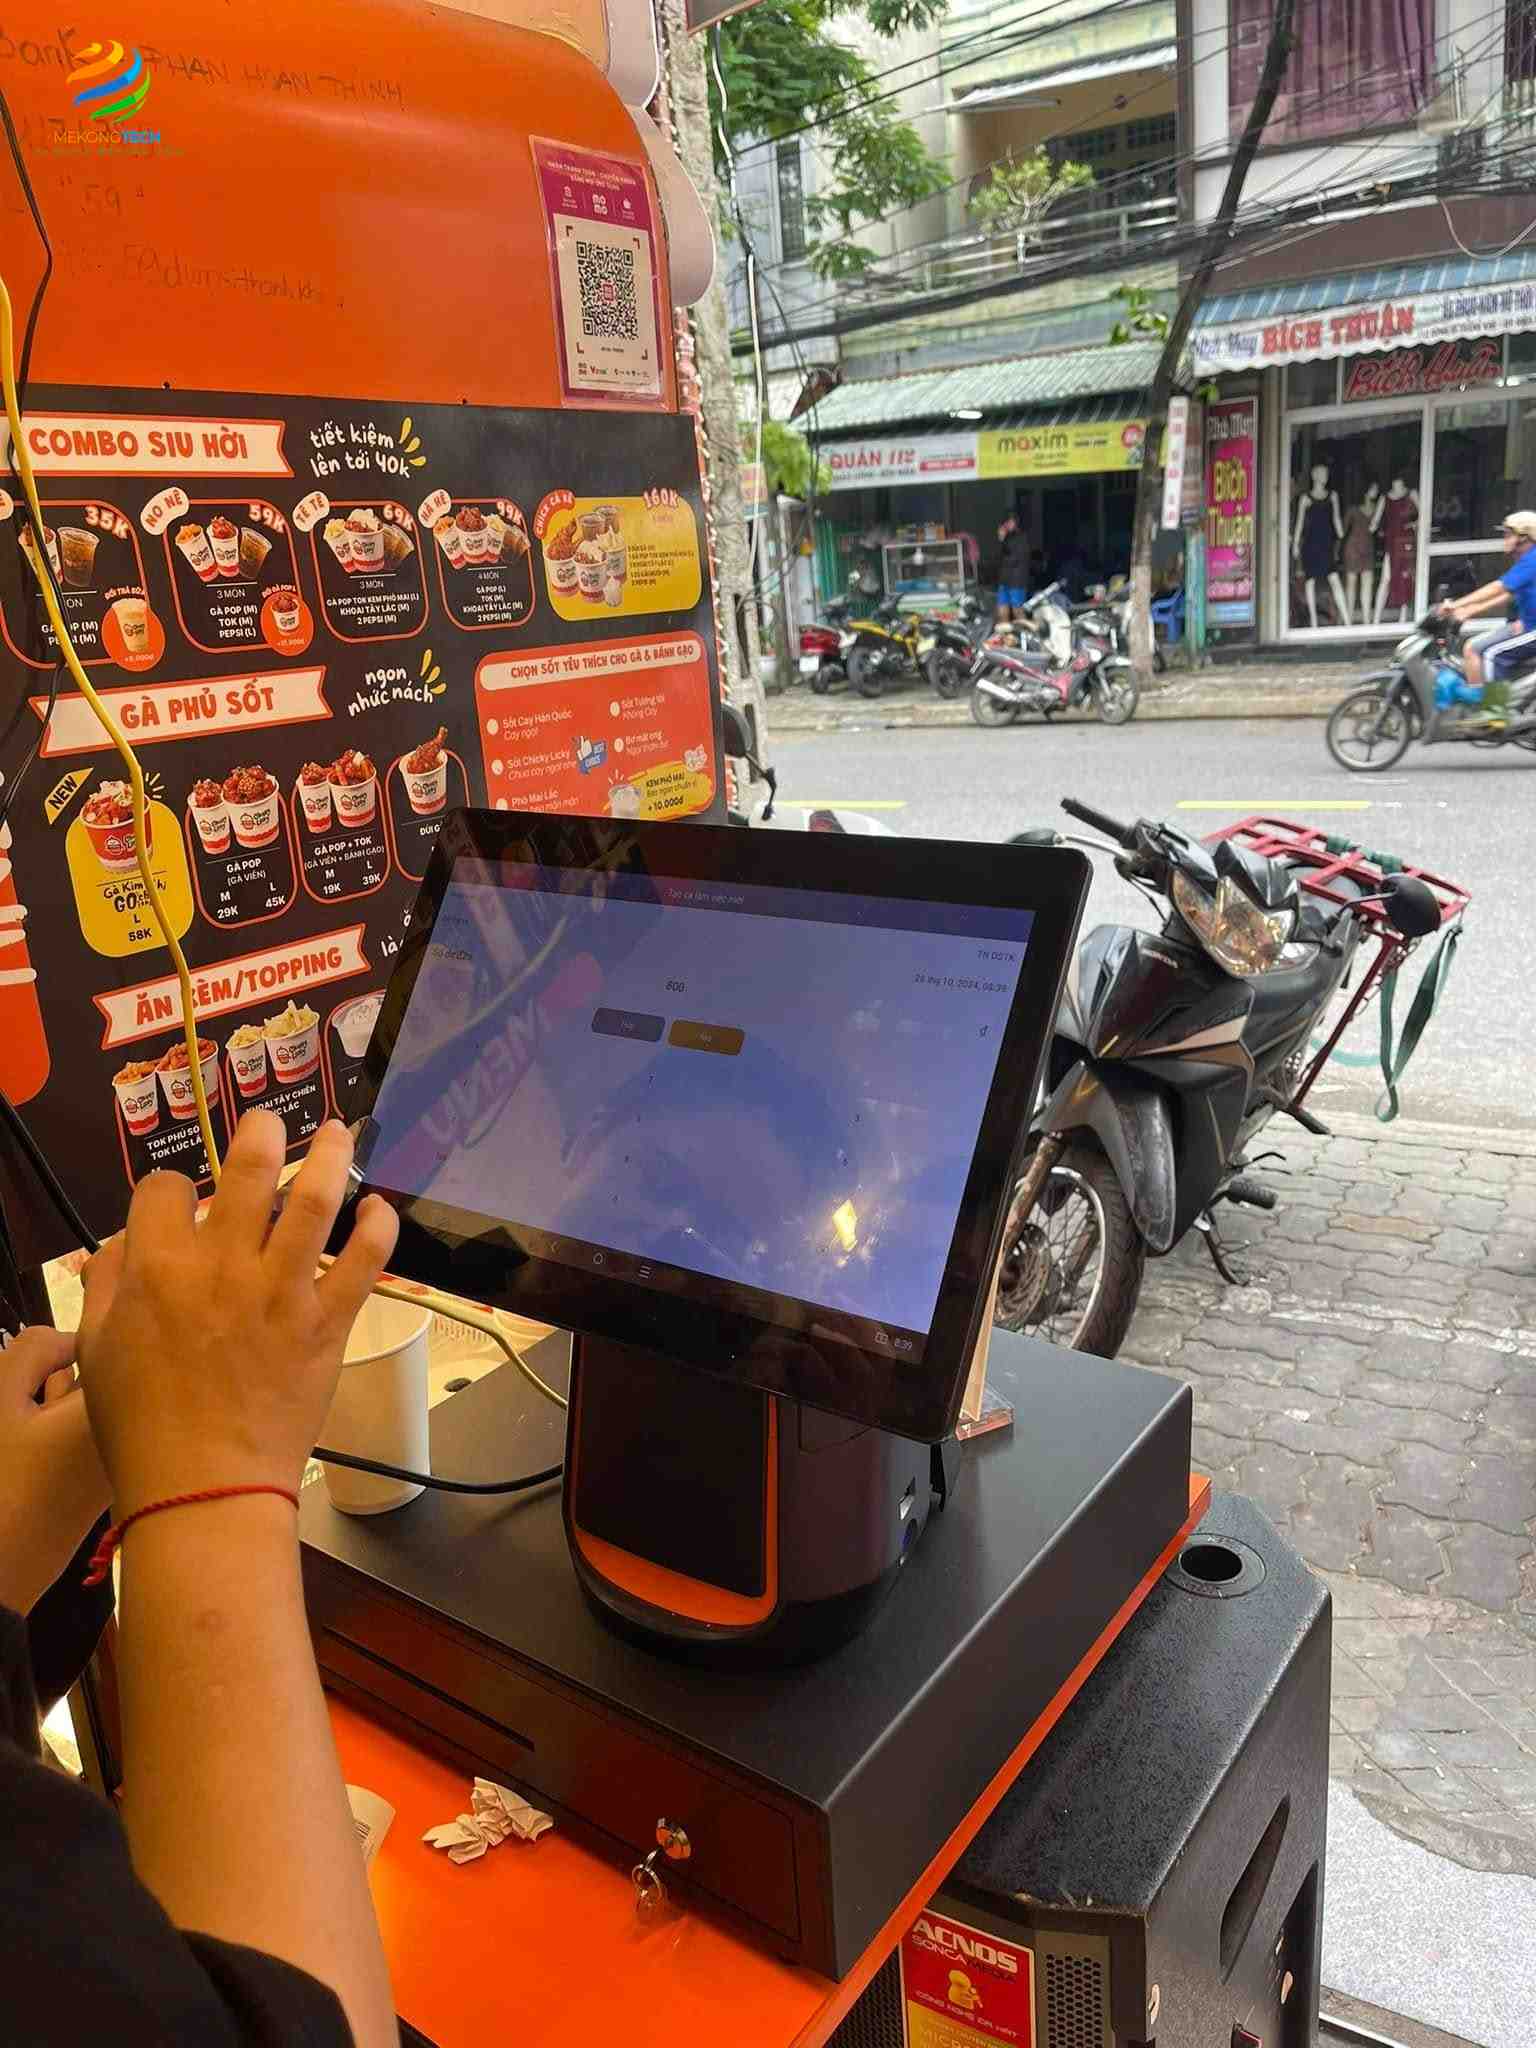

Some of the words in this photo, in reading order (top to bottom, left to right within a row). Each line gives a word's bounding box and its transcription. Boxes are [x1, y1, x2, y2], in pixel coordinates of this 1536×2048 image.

[29, 428, 139, 457] COMBO
[148, 431, 194, 458] SIU
[202, 425, 248, 459] HỜI
[310, 420, 346, 448] tiết
[350, 422, 394, 448] kiệm
[999, 428, 1069, 452] maxim
[310, 452, 341, 478] lên
[344, 449, 370, 470] tới
[375, 451, 411, 479] 40k
[643, 487, 679, 509] 160K
[84, 505, 129, 540] 35K
[145, 505, 163, 528] NO
[249, 503, 287, 534] 59K
[383, 503, 414, 532] 69K
[216, 590, 223, 599] 3
[209, 604, 223, 616] GÀ
[224, 605, 241, 615] POP
[243, 604, 258, 615] (M)
[218, 617, 238, 627] TOK
[238, 616, 253, 627] (M)
[219, 628, 243, 639] PEPSI
[244, 627, 257, 638] (L)
[510, 666, 538, 680] CHỌN
[541, 658, 560, 675] SỐT
[583, 653, 608, 670] THÍCH
[610, 653, 628, 666] CHO
[630, 649, 642, 663] GÀ
[653, 645, 675, 660] BÁNH
[676, 645, 694, 659] GẠO
[364, 667, 407, 689] ngon
[120, 695, 160, 730] GÀ
[168, 687, 217, 723] PHỦ
[225, 677, 274, 714] SỐT
[348, 688, 390, 717] nhức
[392, 680, 433, 703] nách
[48, 775, 77, 810] NEW
[314, 844, 329, 856] GÀ
[329, 841, 346, 853] POP
[353, 836, 372, 848] TOK
[226, 860, 241, 873] GÀ
[242, 857, 262, 870] POP
[325, 868, 335, 880] M
[366, 860, 373, 869] L
[269, 882, 277, 892] L
[323, 882, 342, 895] 19K
[362, 873, 381, 886] 39K
[103, 884, 120, 899] Gà
[122, 881, 144, 896] Kim
[220, 891, 231, 902] M
[113, 893, 137, 913] GO
[265, 895, 286, 908] 45K
[133, 914, 141, 924] L
[217, 905, 239, 919] 29K
[128, 927, 152, 942] 58K
[136, 991, 173, 1026] ĂN
[191, 946, 342, 1009] ÈM/TOPPING
[274, 1090, 291, 1106] TÂY
[291, 1083, 316, 1099] CHIÊN
[303, 1110, 311, 1120] L
[300, 1121, 318, 1136] 35K
[147, 1136, 166, 1151] TOK
[151, 1147, 171, 1161] TOK
[912, 1934, 968, 1966] SONCA
[913, 1918, 1018, 1974] ACNOS
